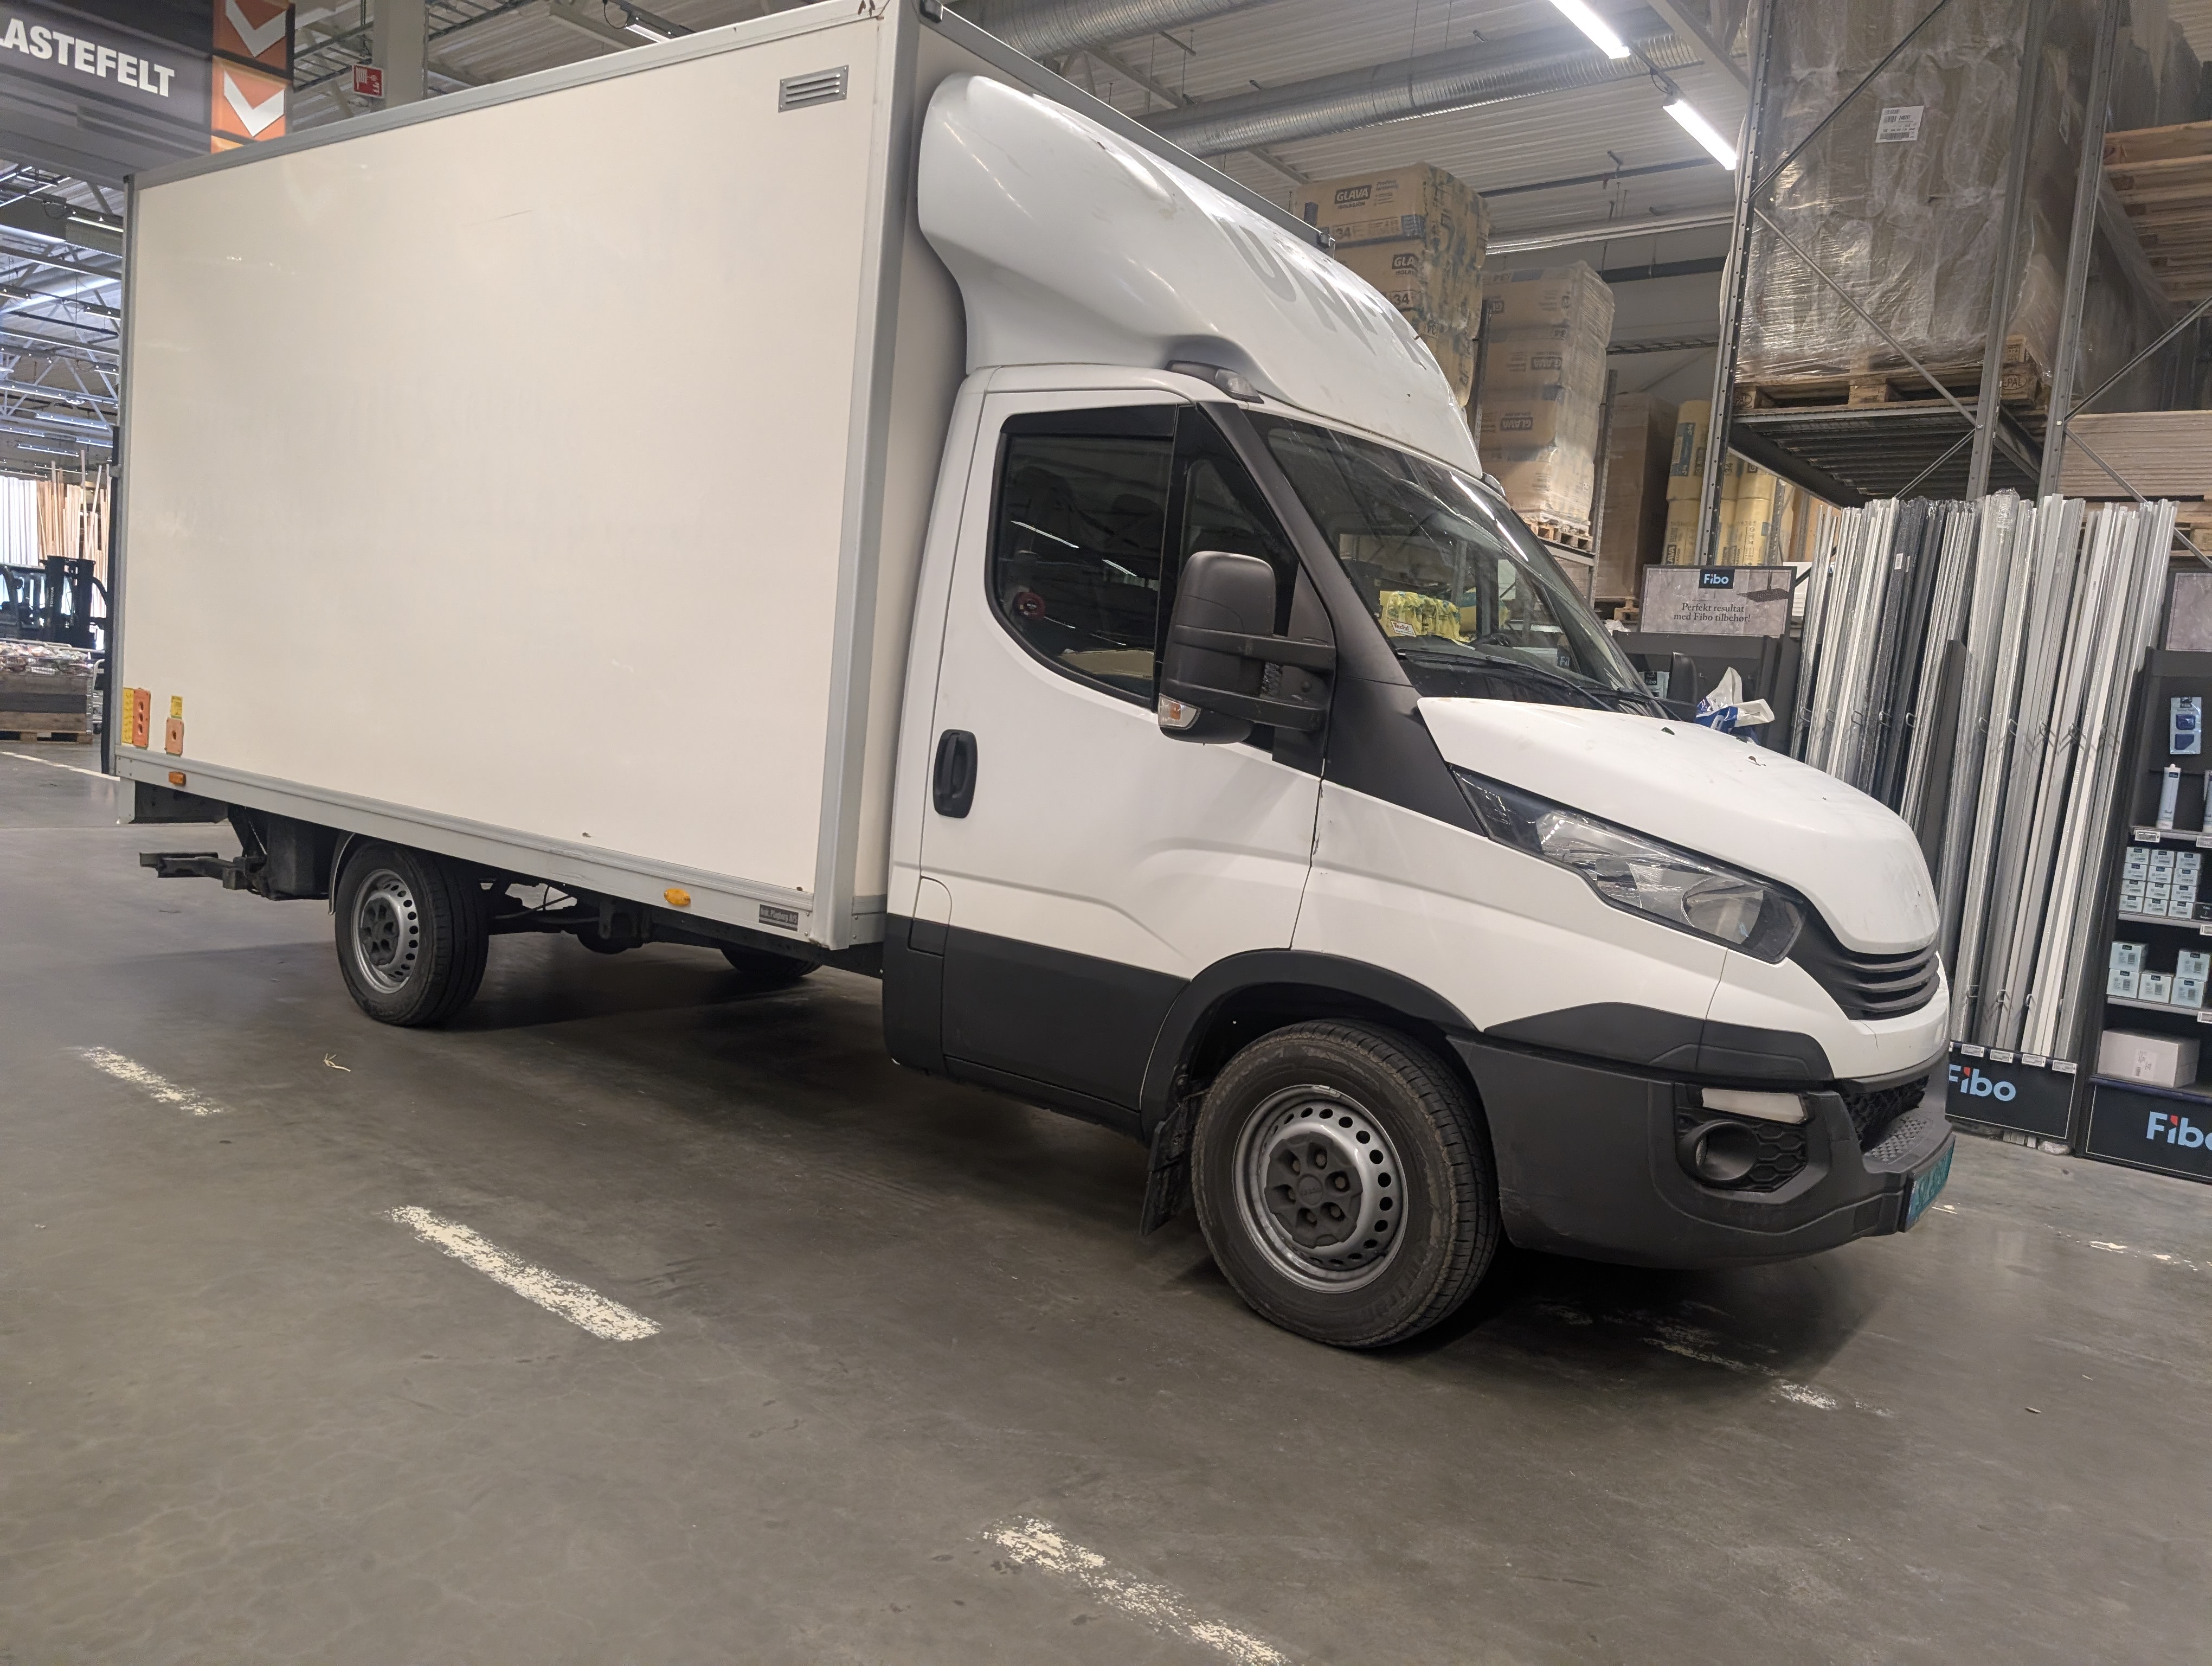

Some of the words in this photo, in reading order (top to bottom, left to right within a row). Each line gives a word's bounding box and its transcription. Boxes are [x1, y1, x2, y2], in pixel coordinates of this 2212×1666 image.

[0, 18, 175, 98] ASTEFELT
[1335, 187, 1370, 203] GLAVA
[1393, 293, 1410, 306] 34
[1703, 573, 1729, 584] Fibo
[1681, 603, 1712, 612] Perfekt
[1713, 604, 1745, 612] resultat
[1694, 612, 1713, 621] Fibo
[1715, 613, 1751, 623] tilbehør!
[1949, 1063, 2016, 1101] Fibo
